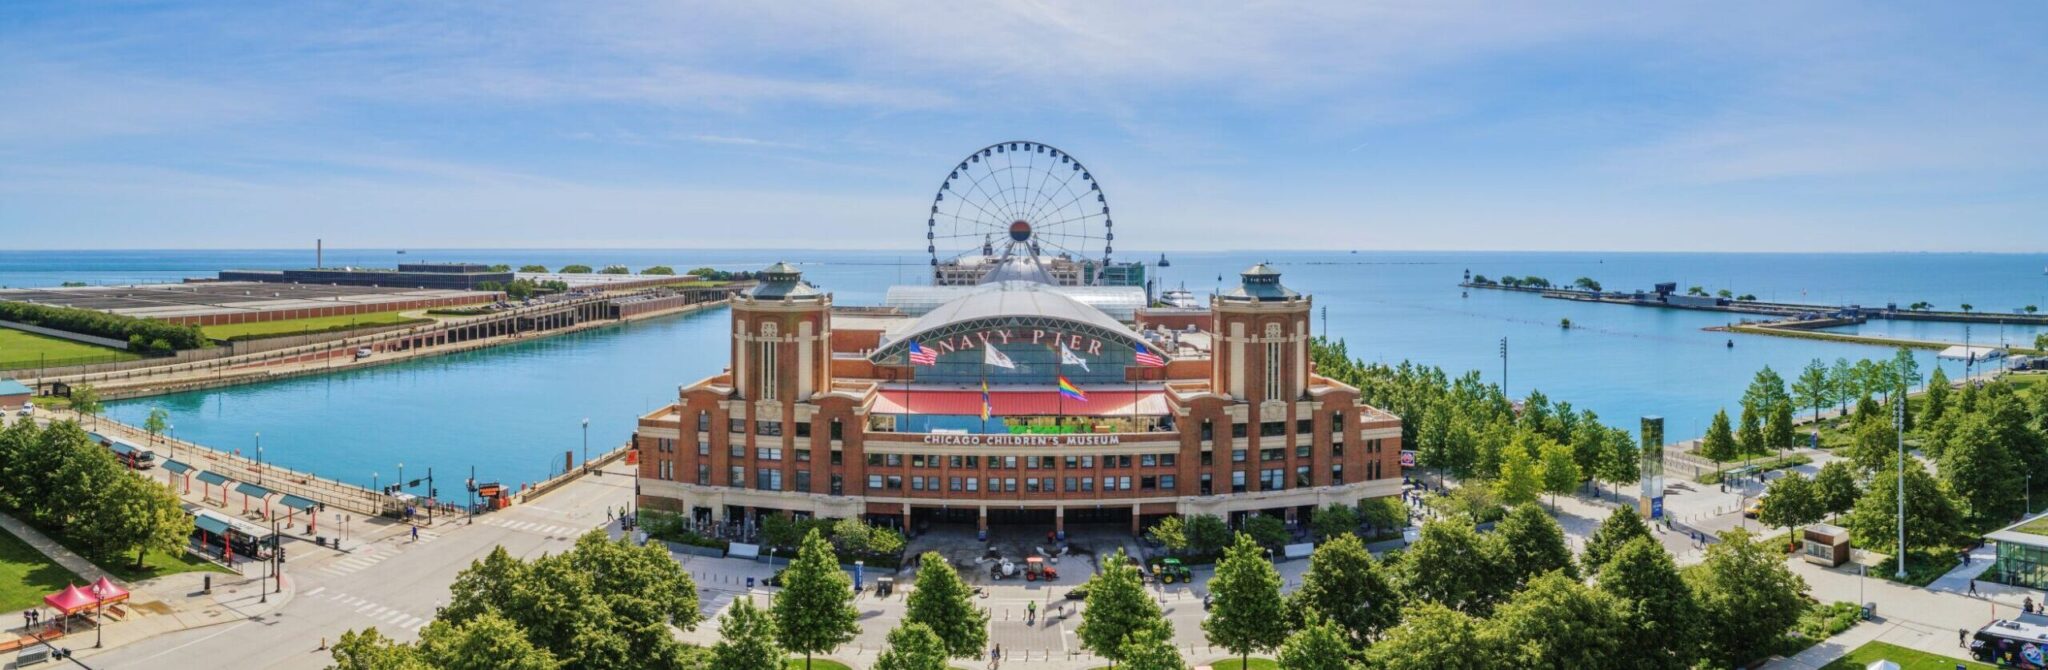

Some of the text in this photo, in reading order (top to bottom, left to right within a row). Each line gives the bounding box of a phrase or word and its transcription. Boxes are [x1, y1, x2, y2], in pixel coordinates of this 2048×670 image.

[938, 329, 1102, 356] NAVY PIER
[923, 435, 1120, 446] CHICAGO CHILDREN'S MUSEUM
